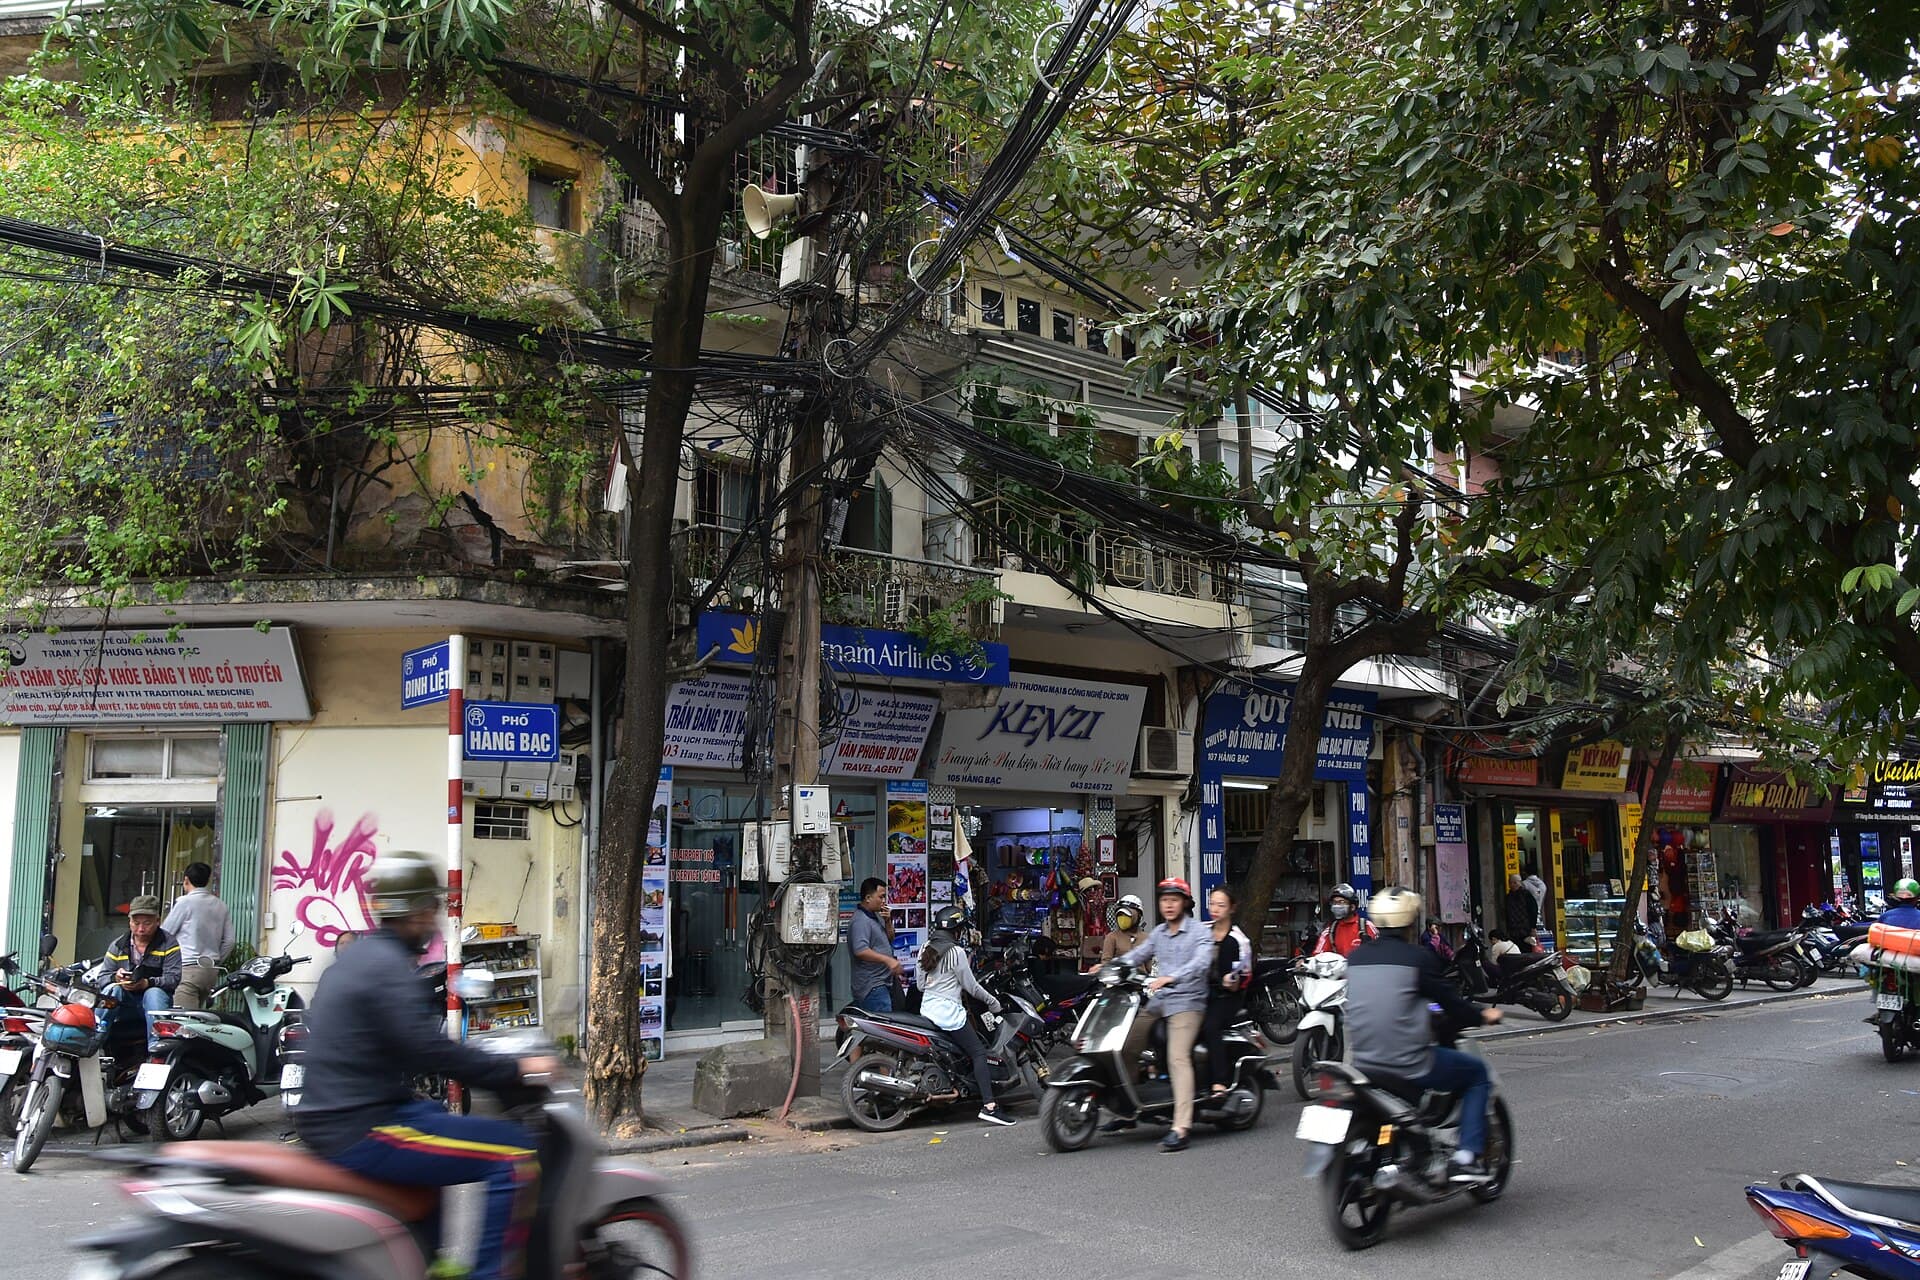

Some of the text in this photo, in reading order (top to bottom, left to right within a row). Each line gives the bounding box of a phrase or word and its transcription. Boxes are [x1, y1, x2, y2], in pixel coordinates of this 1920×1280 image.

[422, 652, 438, 669] PHỐ
[820, 640, 952, 672] tnam Airlines
[20, 666, 56, 687] CHĂM
[56, 664, 82, 686] SÓC
[108, 660, 142, 685] KHỎE
[142, 659, 177, 684] BẰNG
[177, 667, 186, 684] Y
[188, 666, 214, 688] HỌC
[234, 658, 283, 683] TRUYỀN
[53, 690, 114, 699] DEPARTMENT
[117, 690, 143, 698] WITH
[144, 689, 205, 697] TRADITIONAL
[206, 688, 254, 697] MEDICINE)
[405, 677, 428, 699] ĐINH
[502, 712, 529, 726] PHỐ
[977, 699, 1105, 747] KENZI
[470, 727, 551, 755] HÀNG BẠC
[663, 744, 679, 757] 03
[842, 763, 904, 774] TRAVEL AGENT
[947, 773, 1002, 786] 105 HÀNG BẠC
[1203, 853, 1221, 874] KHAY
